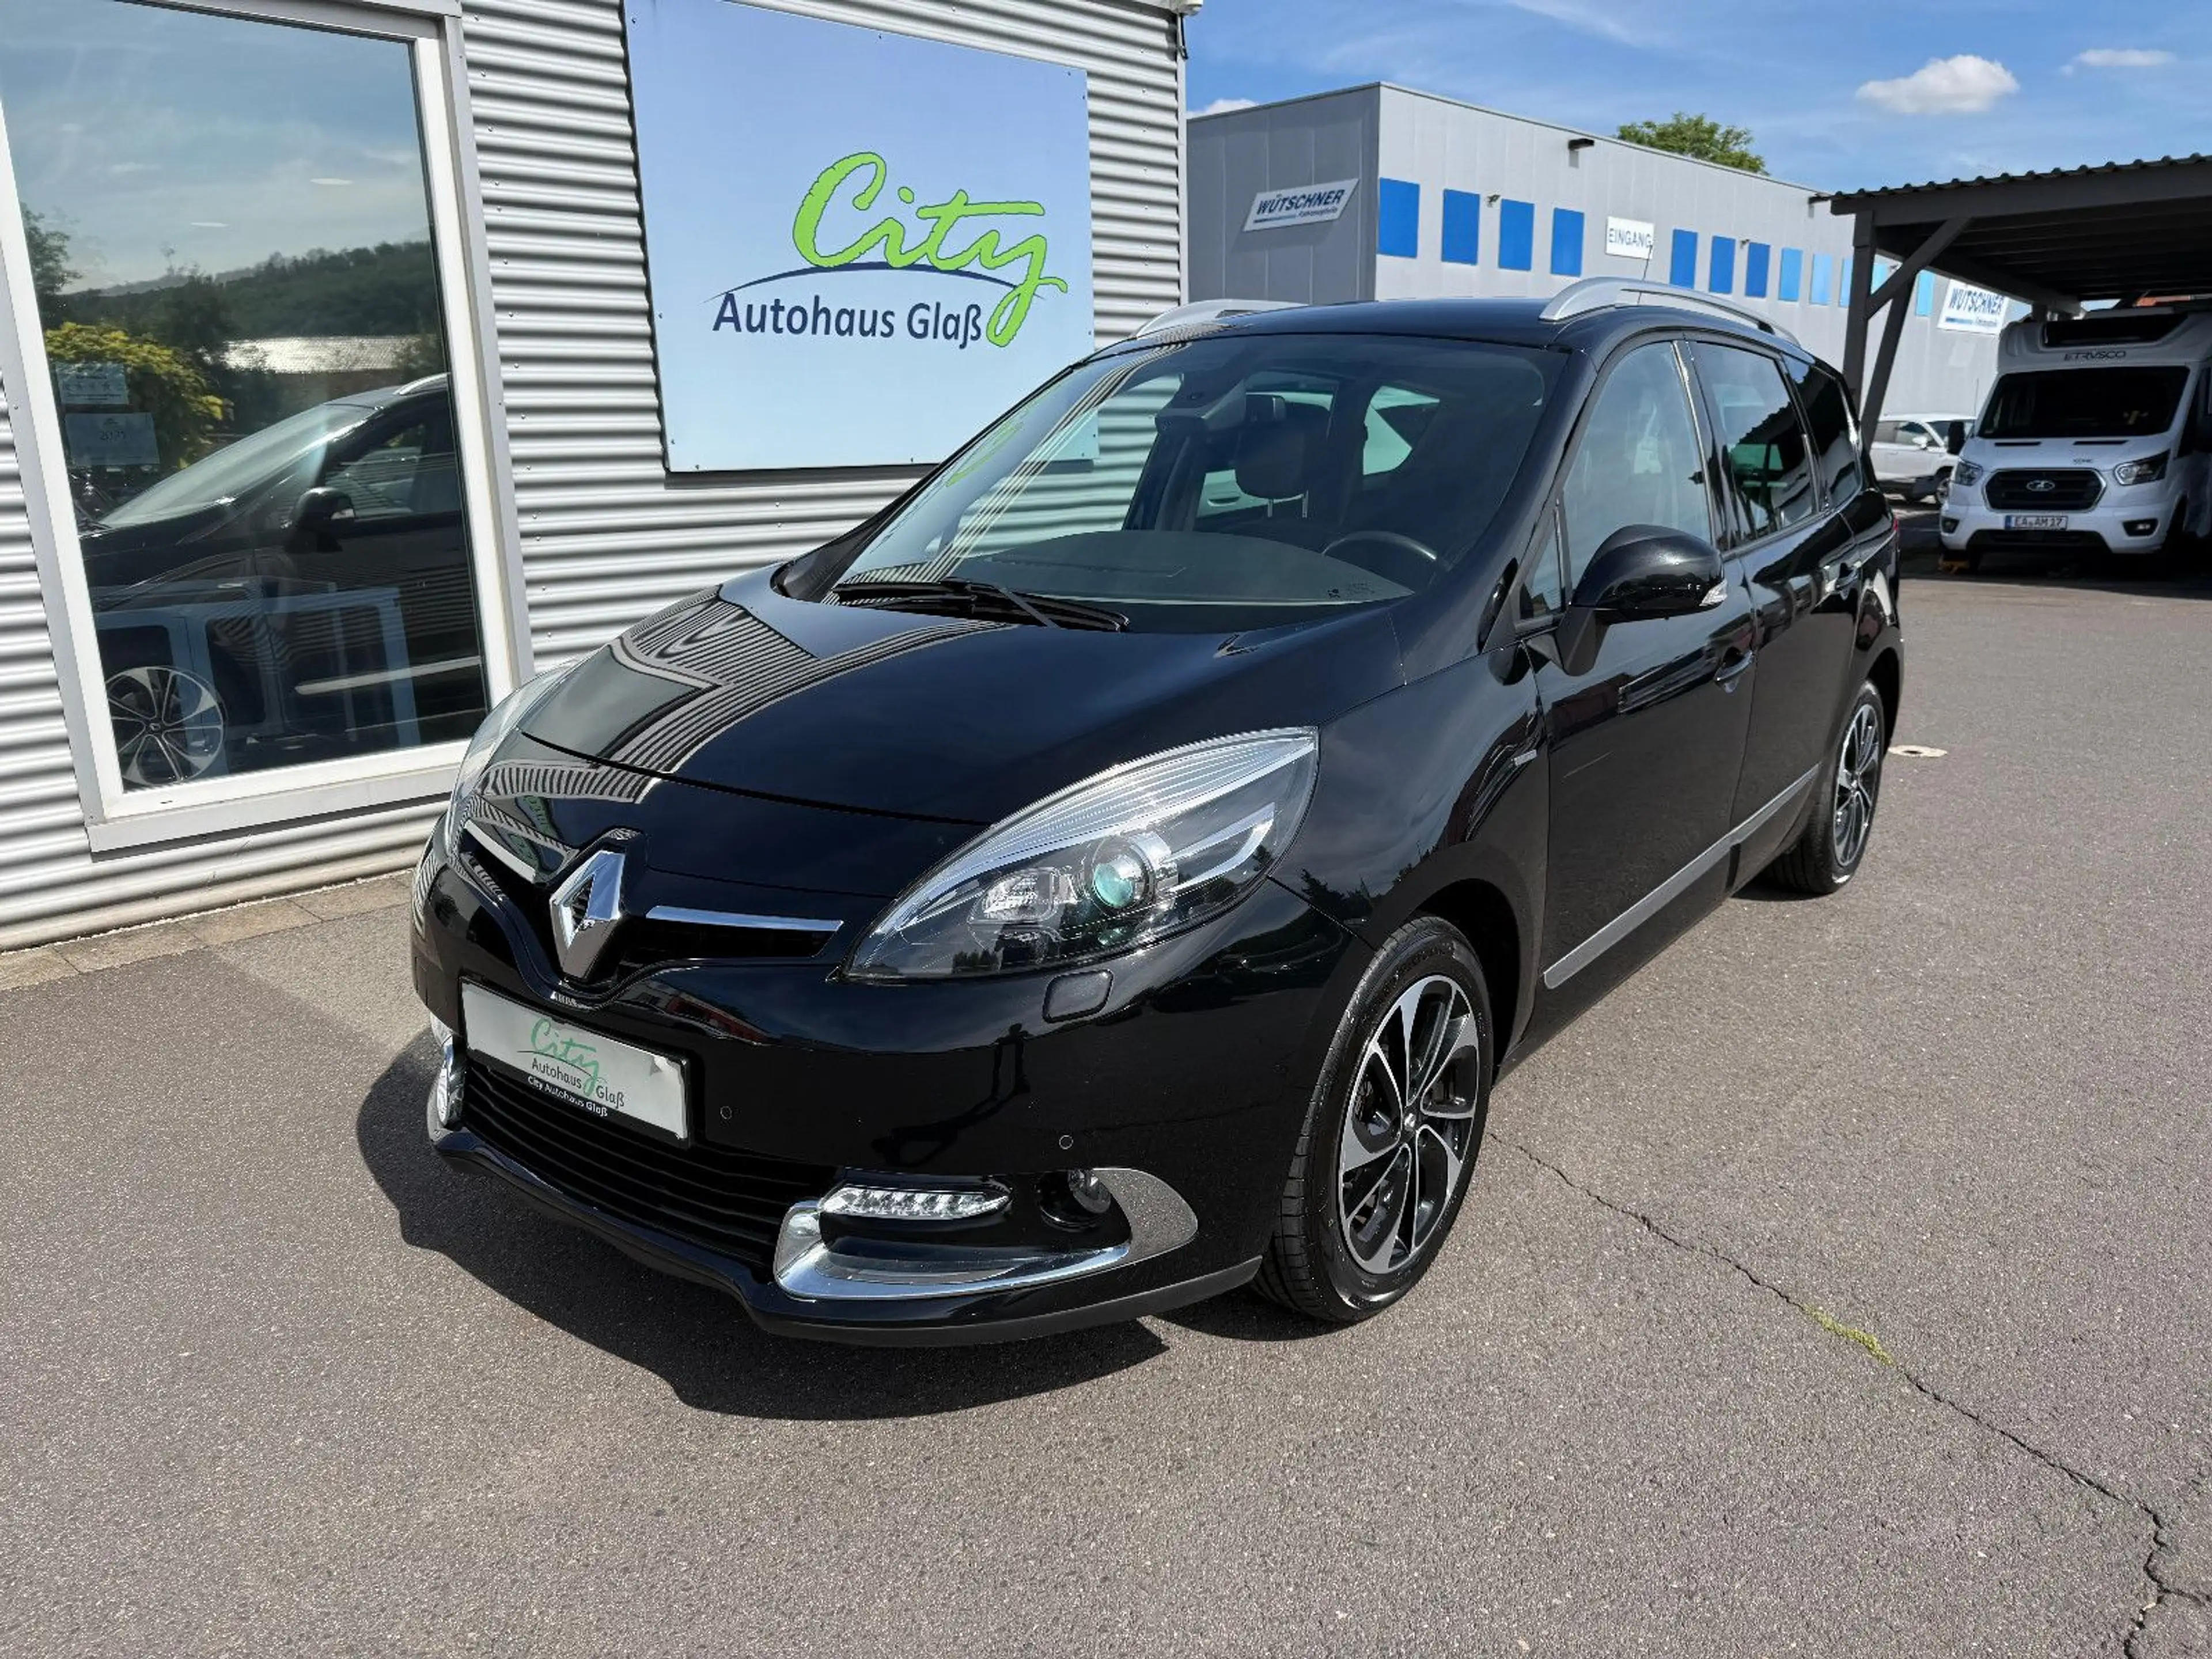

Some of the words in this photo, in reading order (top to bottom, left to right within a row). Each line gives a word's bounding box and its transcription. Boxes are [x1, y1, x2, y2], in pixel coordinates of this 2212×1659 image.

[1256, 189, 1346, 215] WÜTSCHNER
[793, 151, 1068, 348] City
[1608, 228, 1653, 248] EINGANG
[713, 293, 894, 339] Autohaus
[907, 301, 982, 349] Glaß
[531, 1017, 607, 1096] City
[528, 1075, 543, 1090] City
[545, 1083, 584, 1107] Autohaus
[586, 1101, 608, 1116] Glaß
[532, 1058, 582, 1089] Autohaus
[596, 1085, 624, 1109] Glaß
